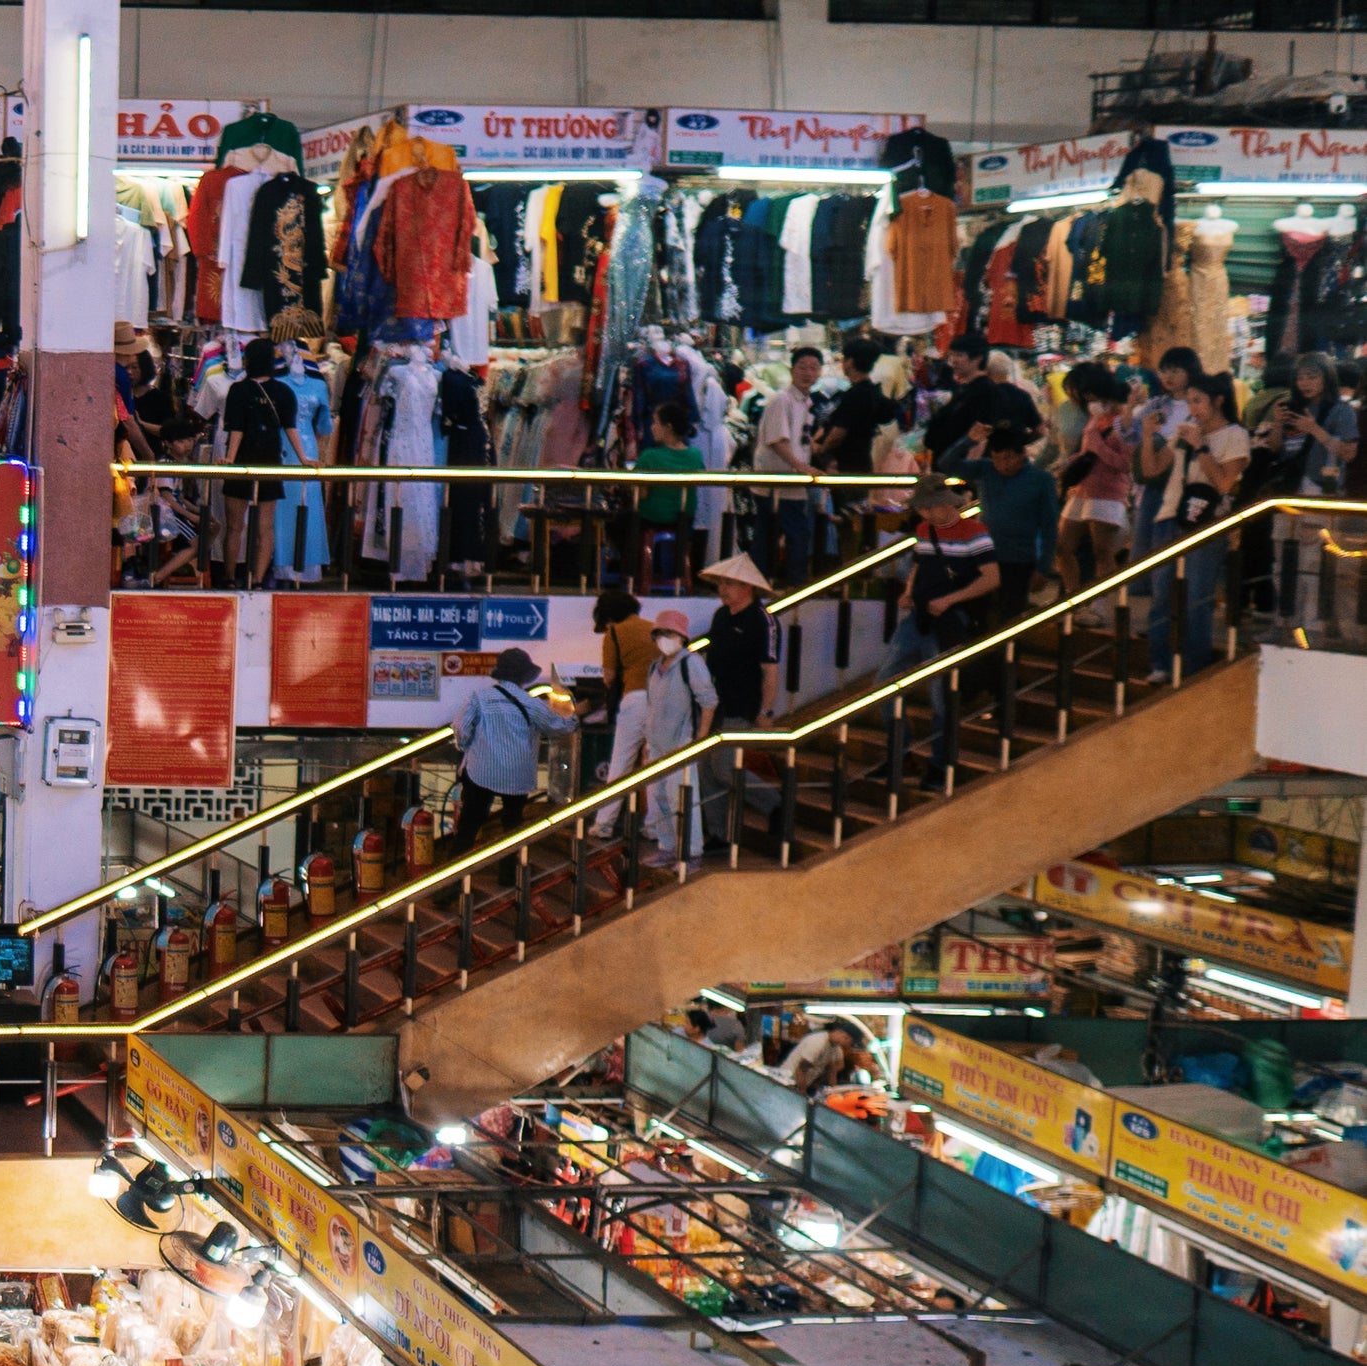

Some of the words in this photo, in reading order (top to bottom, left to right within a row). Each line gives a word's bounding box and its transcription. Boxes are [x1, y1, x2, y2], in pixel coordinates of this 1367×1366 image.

[484, 112, 517, 138] ÚT
[522, 116, 617, 140] THƯƠNG
[505, 615, 538, 624] TOILET
[387, 628, 418, 640] TẦNG
[422, 632, 429, 640] 2
